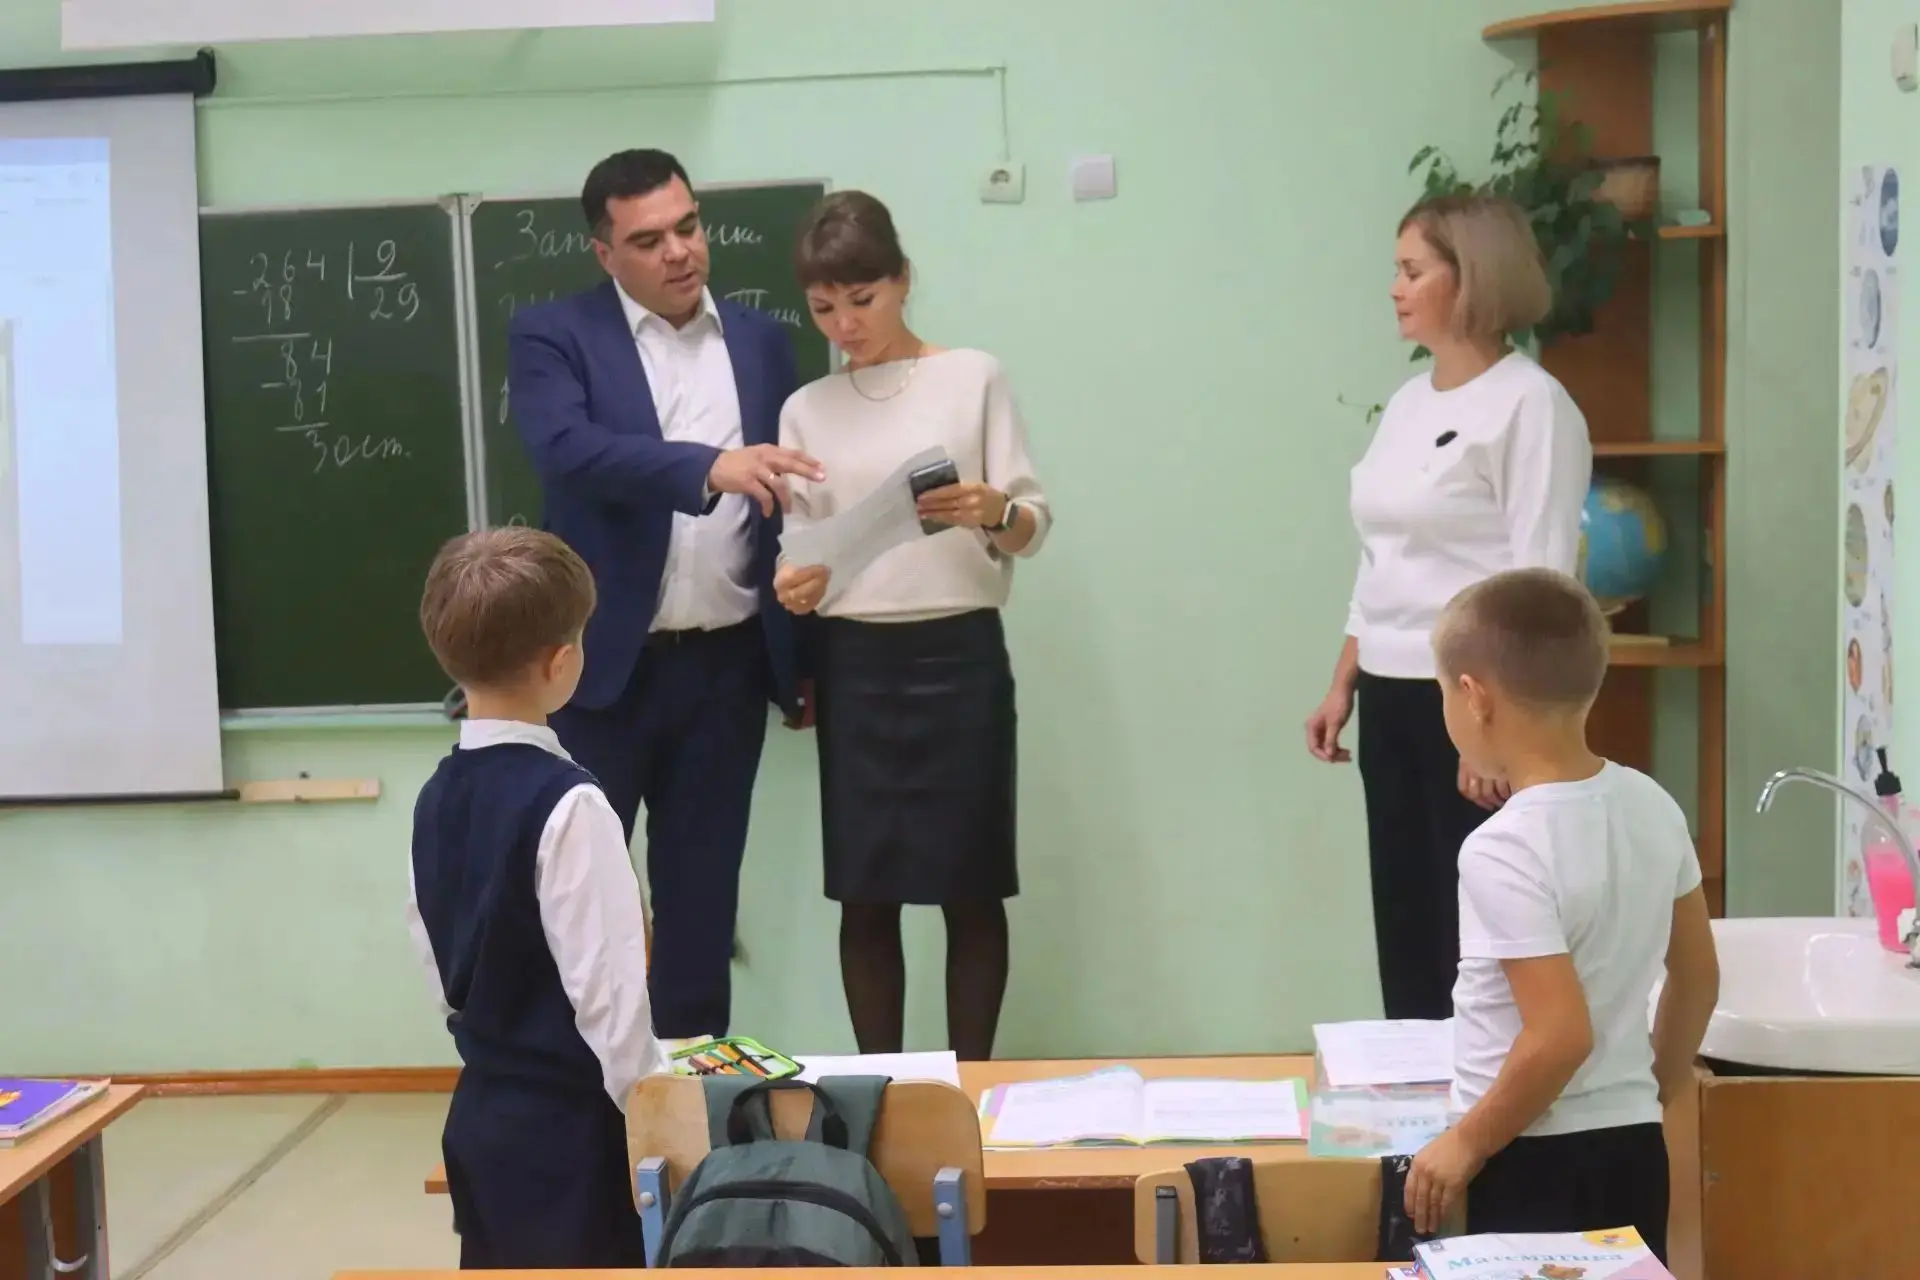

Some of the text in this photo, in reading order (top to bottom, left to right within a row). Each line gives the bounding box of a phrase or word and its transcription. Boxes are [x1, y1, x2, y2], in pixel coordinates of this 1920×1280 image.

[250, 239, 397, 290] 264 9
[369, 282, 421, 323] 29
[280, 336, 333, 381] 84
[1447, 1253, 1624, 1271] Математика
